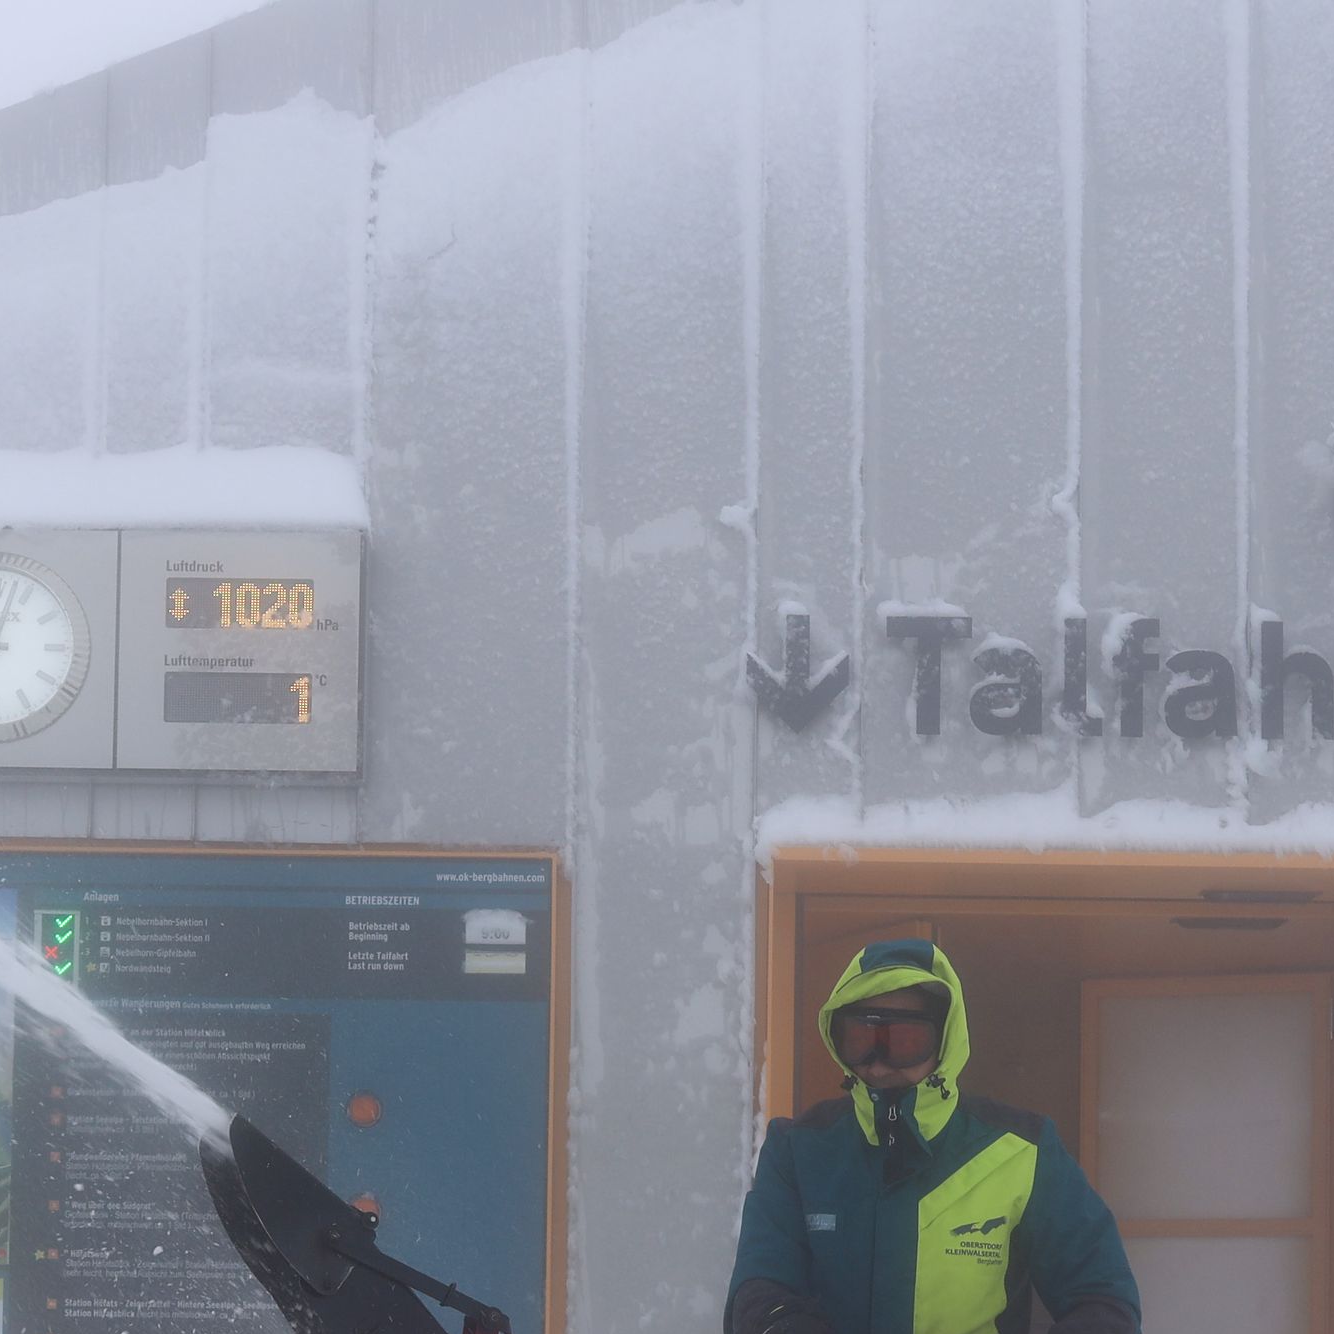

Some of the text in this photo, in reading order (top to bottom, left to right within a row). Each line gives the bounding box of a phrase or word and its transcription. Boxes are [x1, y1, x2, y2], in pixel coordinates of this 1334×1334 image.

[166, 560, 224, 573] Luftdruck
[212, 582, 339, 632] 1020 hPa
[164, 655, 255, 670] Lufttemperatur
[290, 676, 309, 724] 1
[436, 872, 545, 884] www.ok-bergbahnen.com
[83, 891, 119, 904] Anlagen
[345, 895, 419, 906] BETRIEBSZEITEN
[348, 921, 410, 931] Betriebszeit ab
[348, 931, 388, 942] Beginning
[348, 952, 408, 961] Letzte Talfahrt
[348, 961, 404, 971] Last run down
[122, 998, 181, 1011] Wanderungen
[156, 1028, 183, 1037] Station
[960, 1241, 1003, 1250] OBERSTDORF
[945, 1248, 1001, 1258] KLEINWALSERTAL
